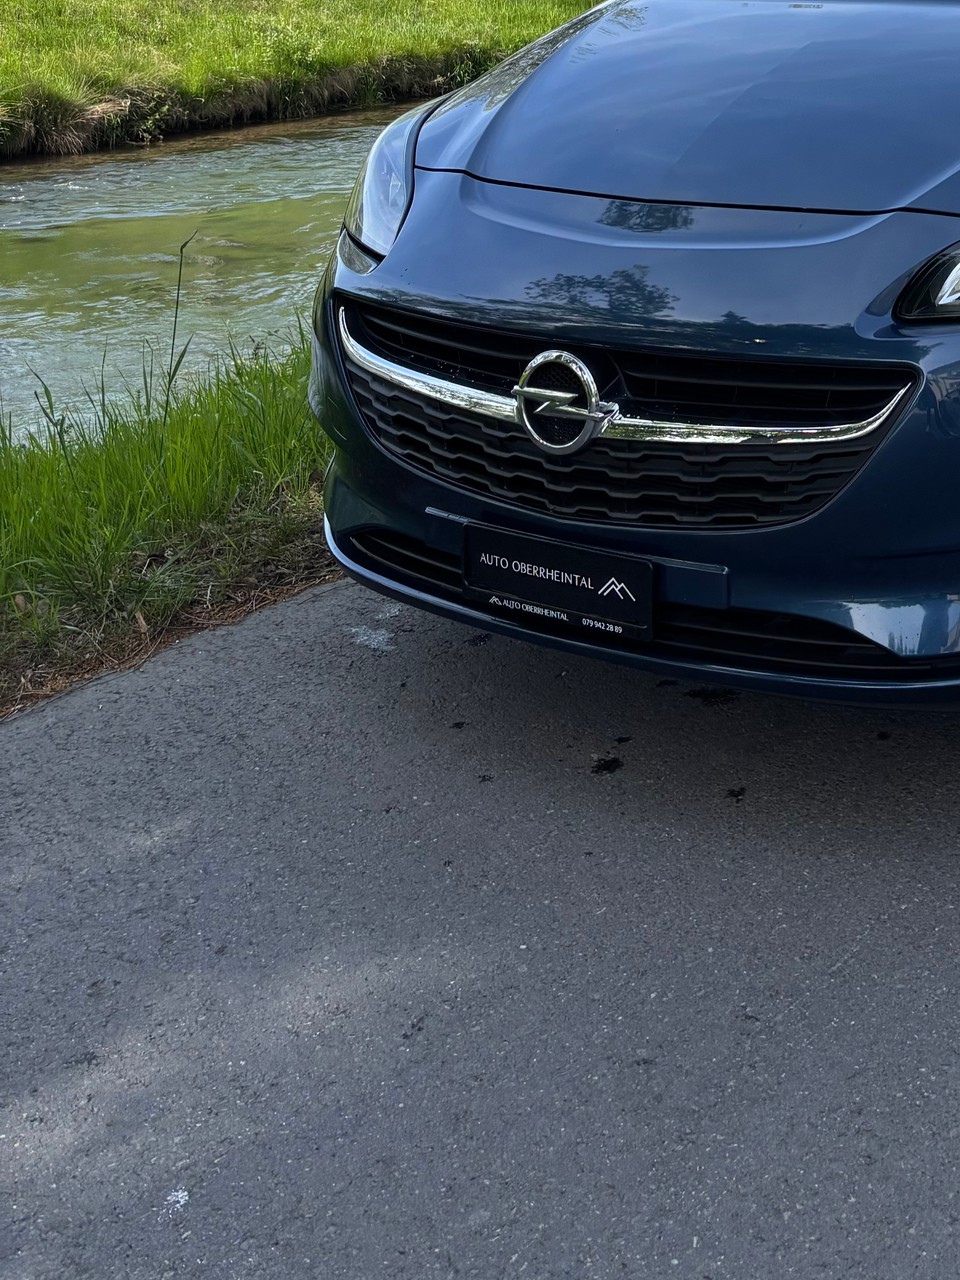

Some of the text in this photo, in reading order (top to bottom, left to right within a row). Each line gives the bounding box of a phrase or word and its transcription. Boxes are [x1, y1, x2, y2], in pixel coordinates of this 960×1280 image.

[480, 553, 594, 589] AUTO OBERRHEINTAL
[502, 599, 569, 621] AUTO OBERRHEINTAL
[582, 618, 622, 633] 079 942 28 89
